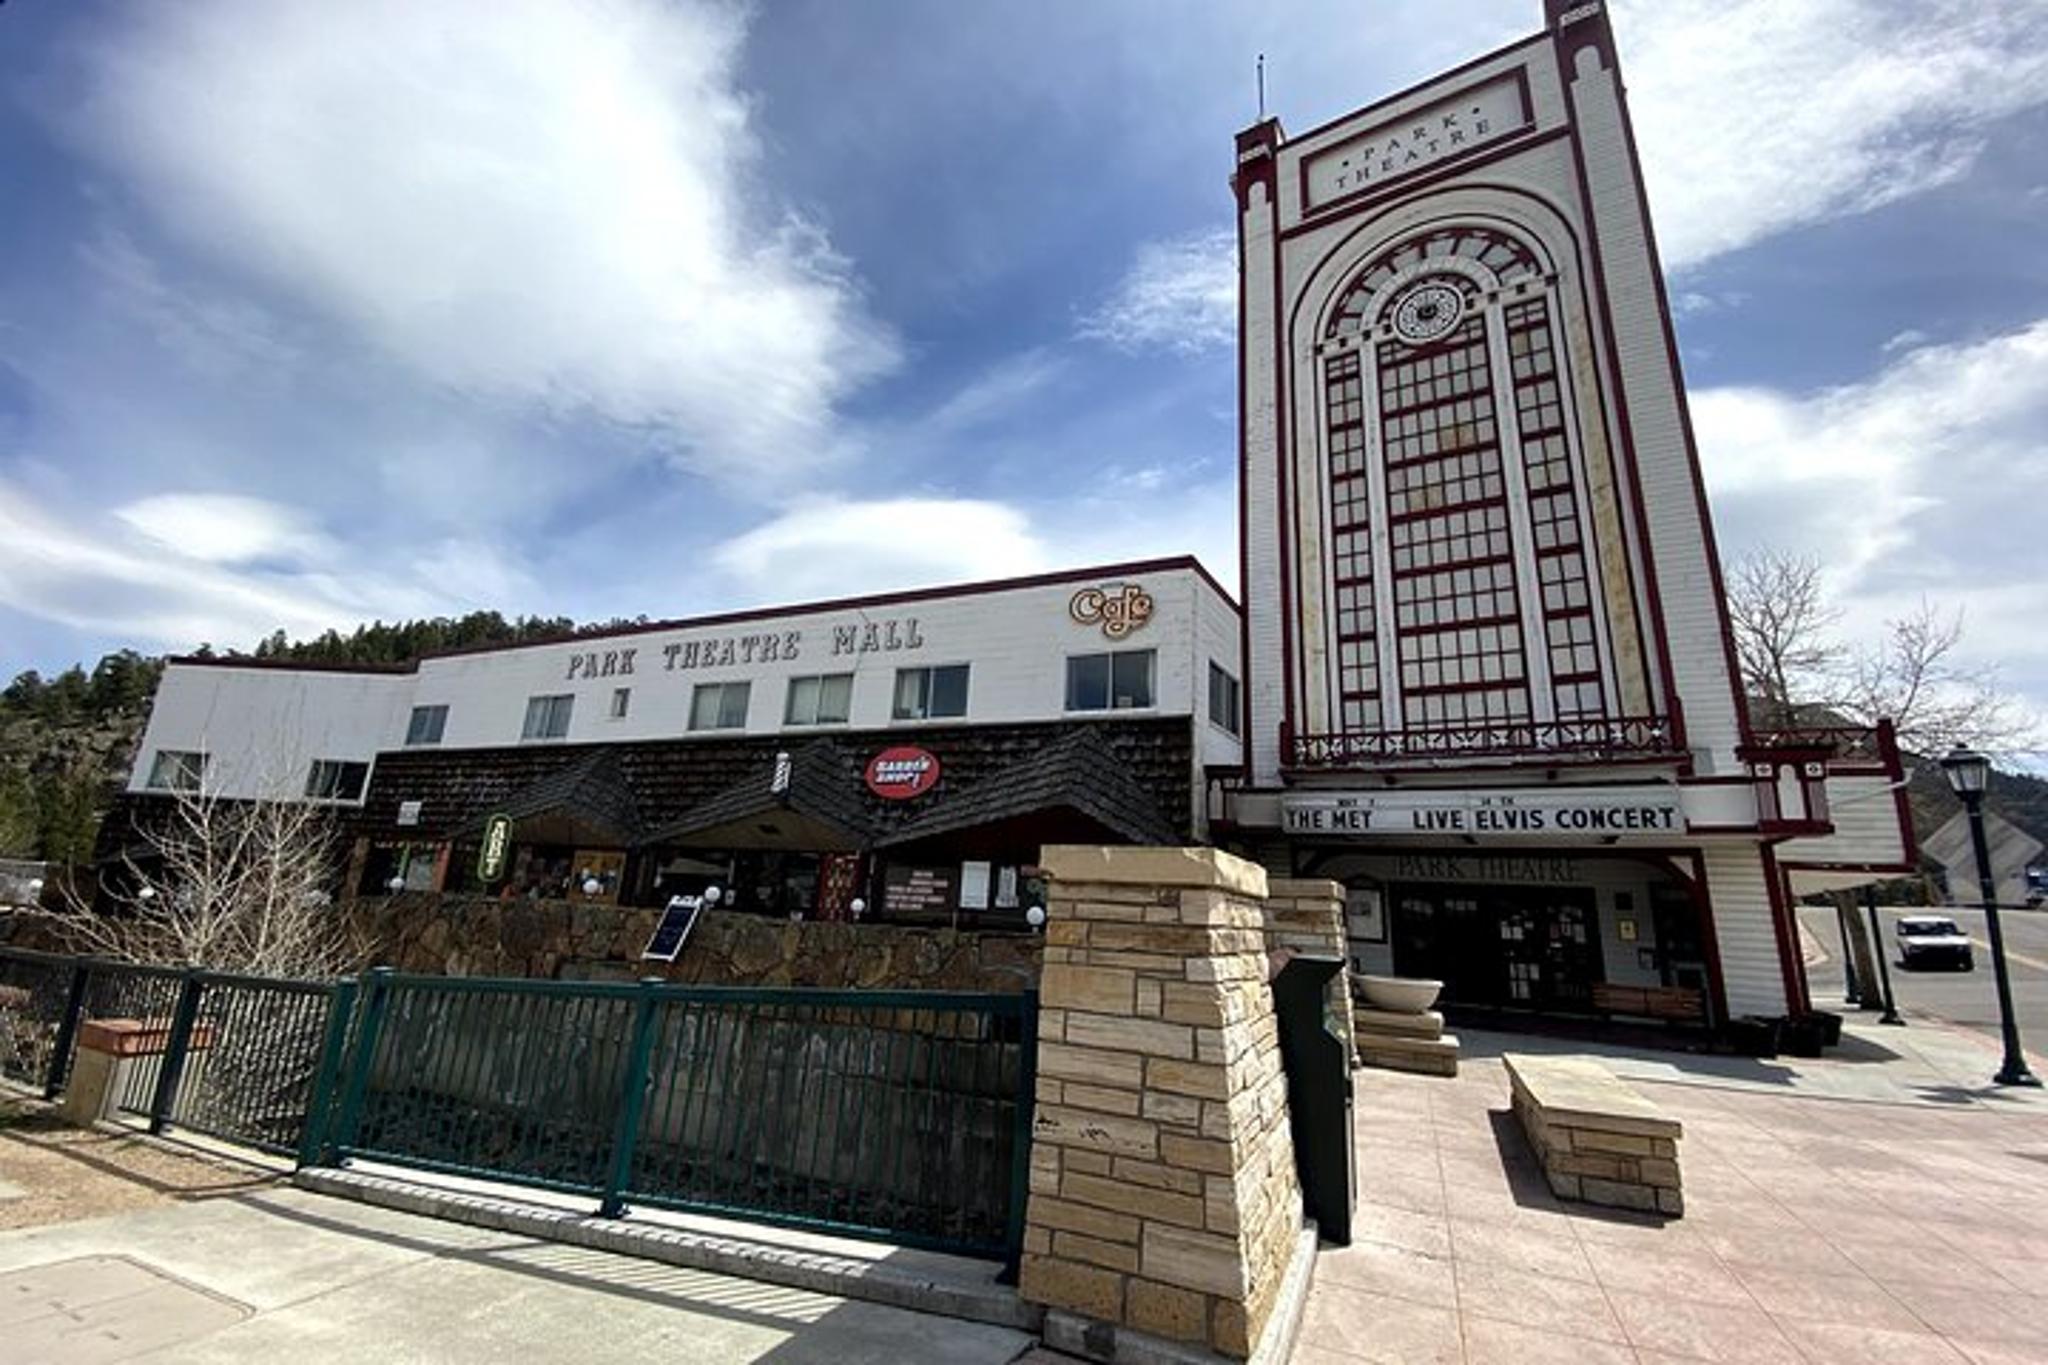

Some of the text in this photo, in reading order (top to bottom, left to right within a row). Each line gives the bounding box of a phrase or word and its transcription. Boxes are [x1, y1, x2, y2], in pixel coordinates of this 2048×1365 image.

[1335, 119, 1490, 189] THEATRE
[1364, 113, 1458, 161] PARK
[566, 618, 924, 680] PARK THEATRE MALL
[1287, 809, 1372, 828] THE MET
[1412, 807, 1675, 830] LIVE ELVIS CONCERT
[1398, 856, 1581, 883] PARK THEATRE
